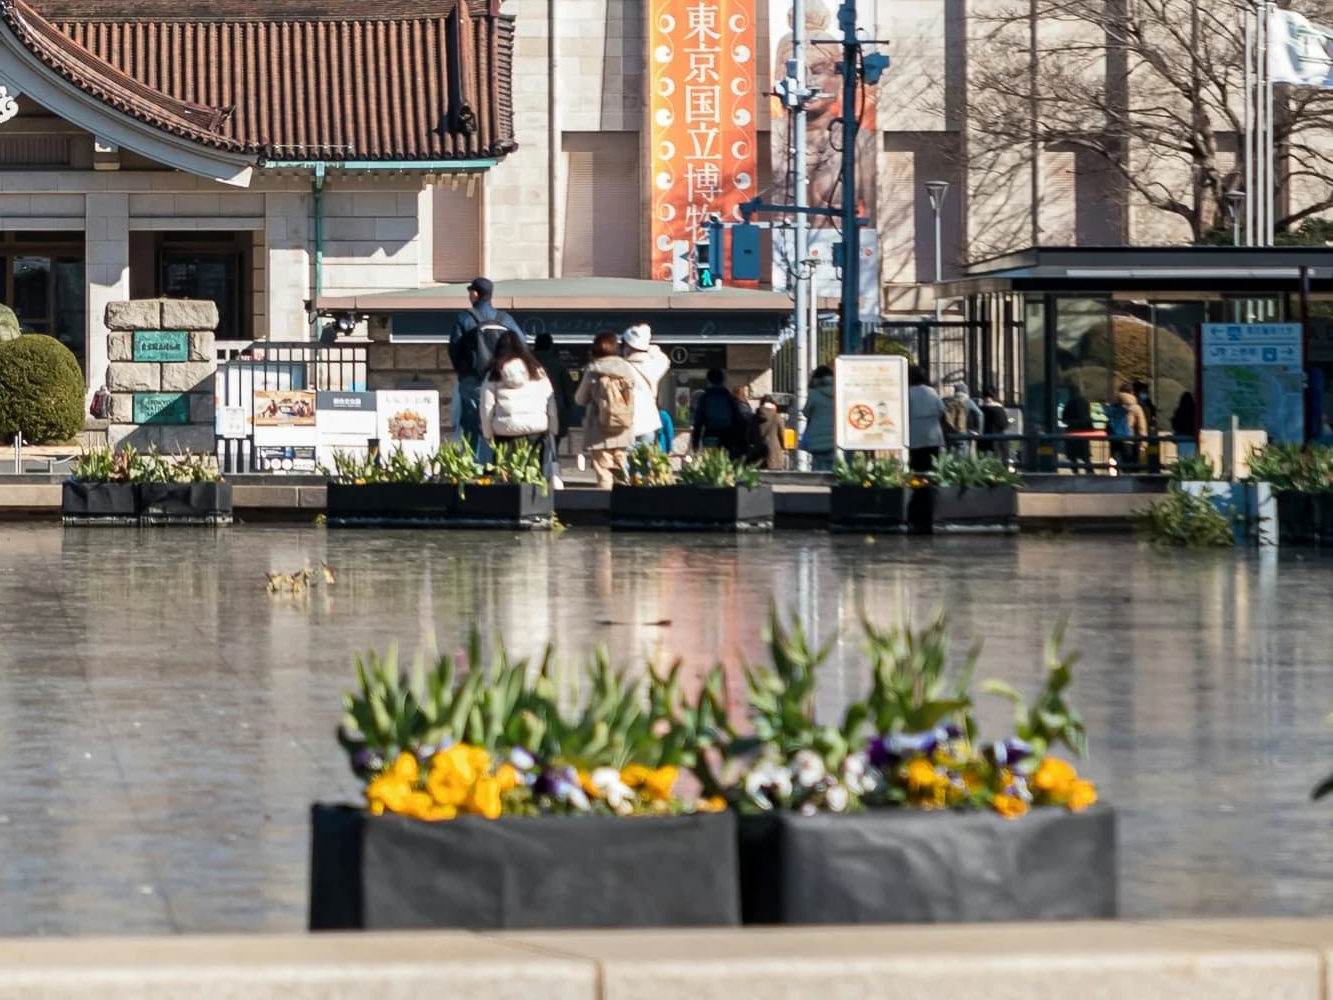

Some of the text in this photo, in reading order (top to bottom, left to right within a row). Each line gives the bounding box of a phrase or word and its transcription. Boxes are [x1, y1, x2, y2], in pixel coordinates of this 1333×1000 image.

[683, 1, 723, 285] 東京国立博物
